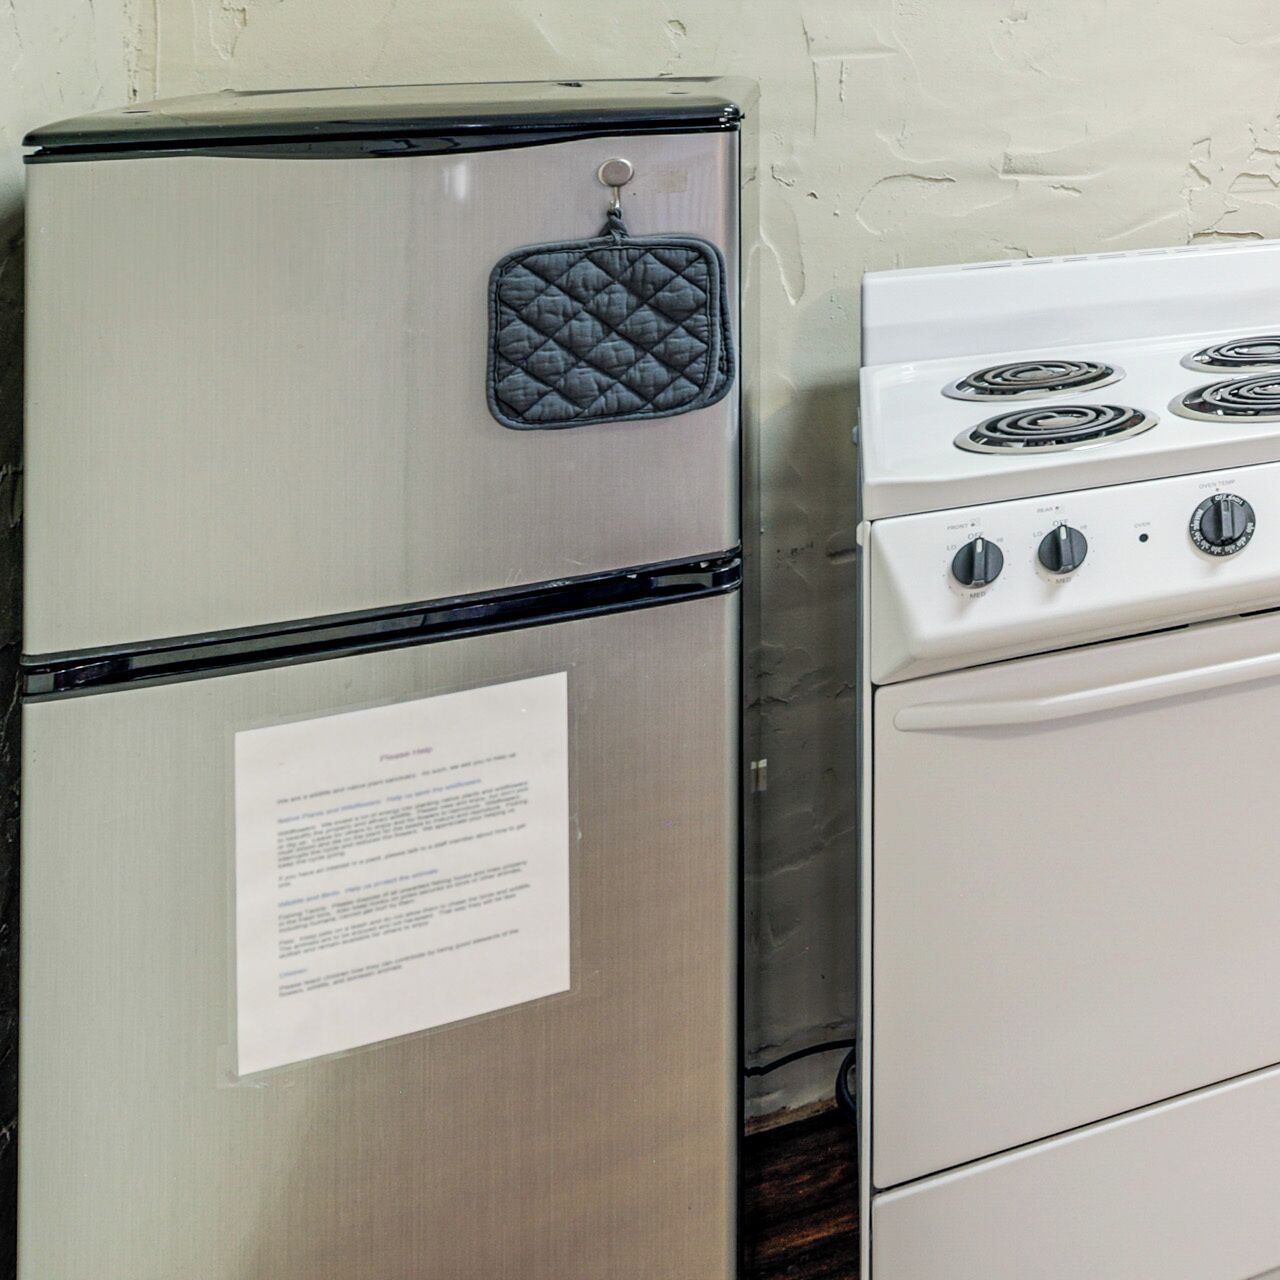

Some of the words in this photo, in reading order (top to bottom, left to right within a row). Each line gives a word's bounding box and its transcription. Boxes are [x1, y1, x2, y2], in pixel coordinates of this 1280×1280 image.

[1052, 518, 1069, 526] OFF
[1133, 521, 1151, 529] OVEN
[946, 522, 968, 531] FRONT
[967, 531, 984, 540] OFF
[946, 544, 957, 552] LO
[969, 591, 986, 599] MED
